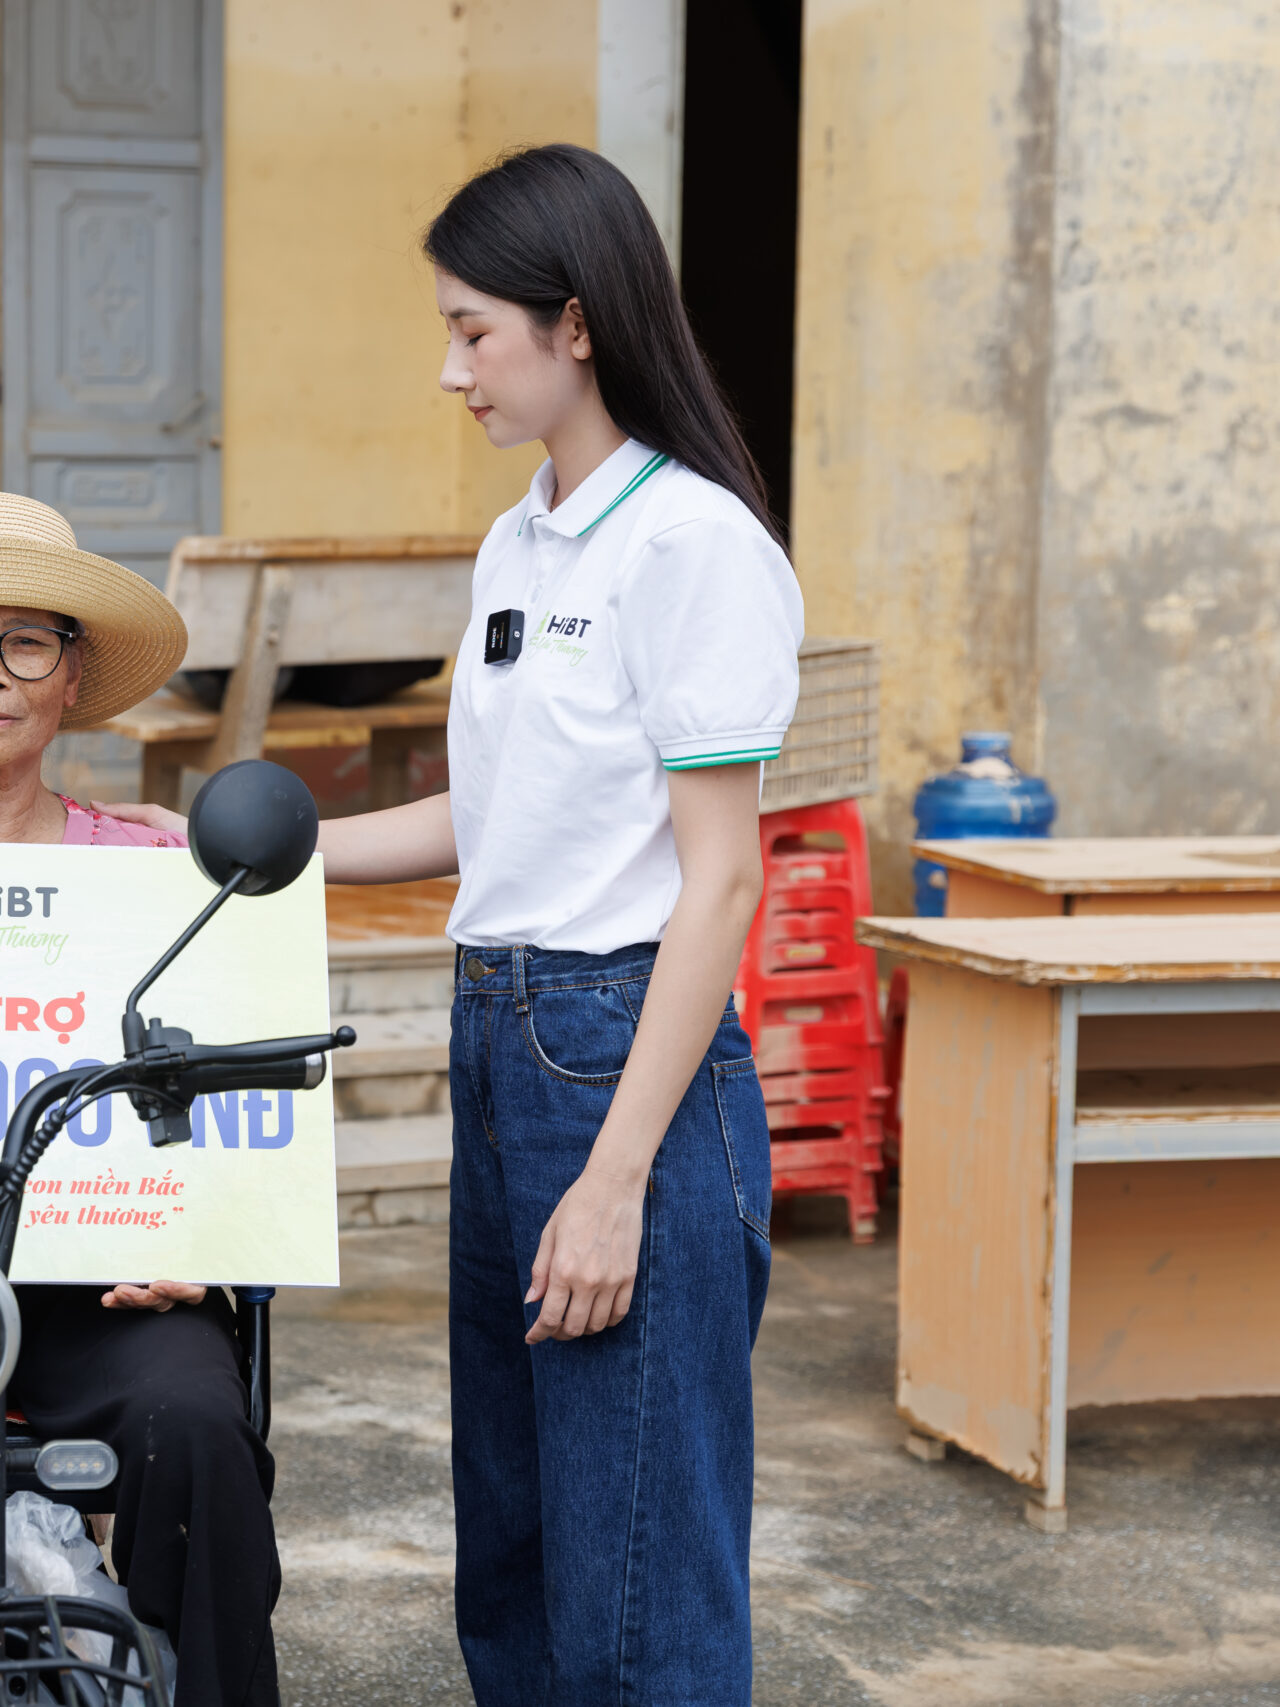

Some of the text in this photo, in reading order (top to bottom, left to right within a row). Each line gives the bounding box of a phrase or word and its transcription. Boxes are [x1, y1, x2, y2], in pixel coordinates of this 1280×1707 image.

[547, 614, 592, 638] HiBT
[145, 1089, 294, 1150] NĐ
[70, 1168, 131, 1196] miền
[137, 1169, 185, 1196] Bắc
[24, 1204, 70, 1229] yêu
